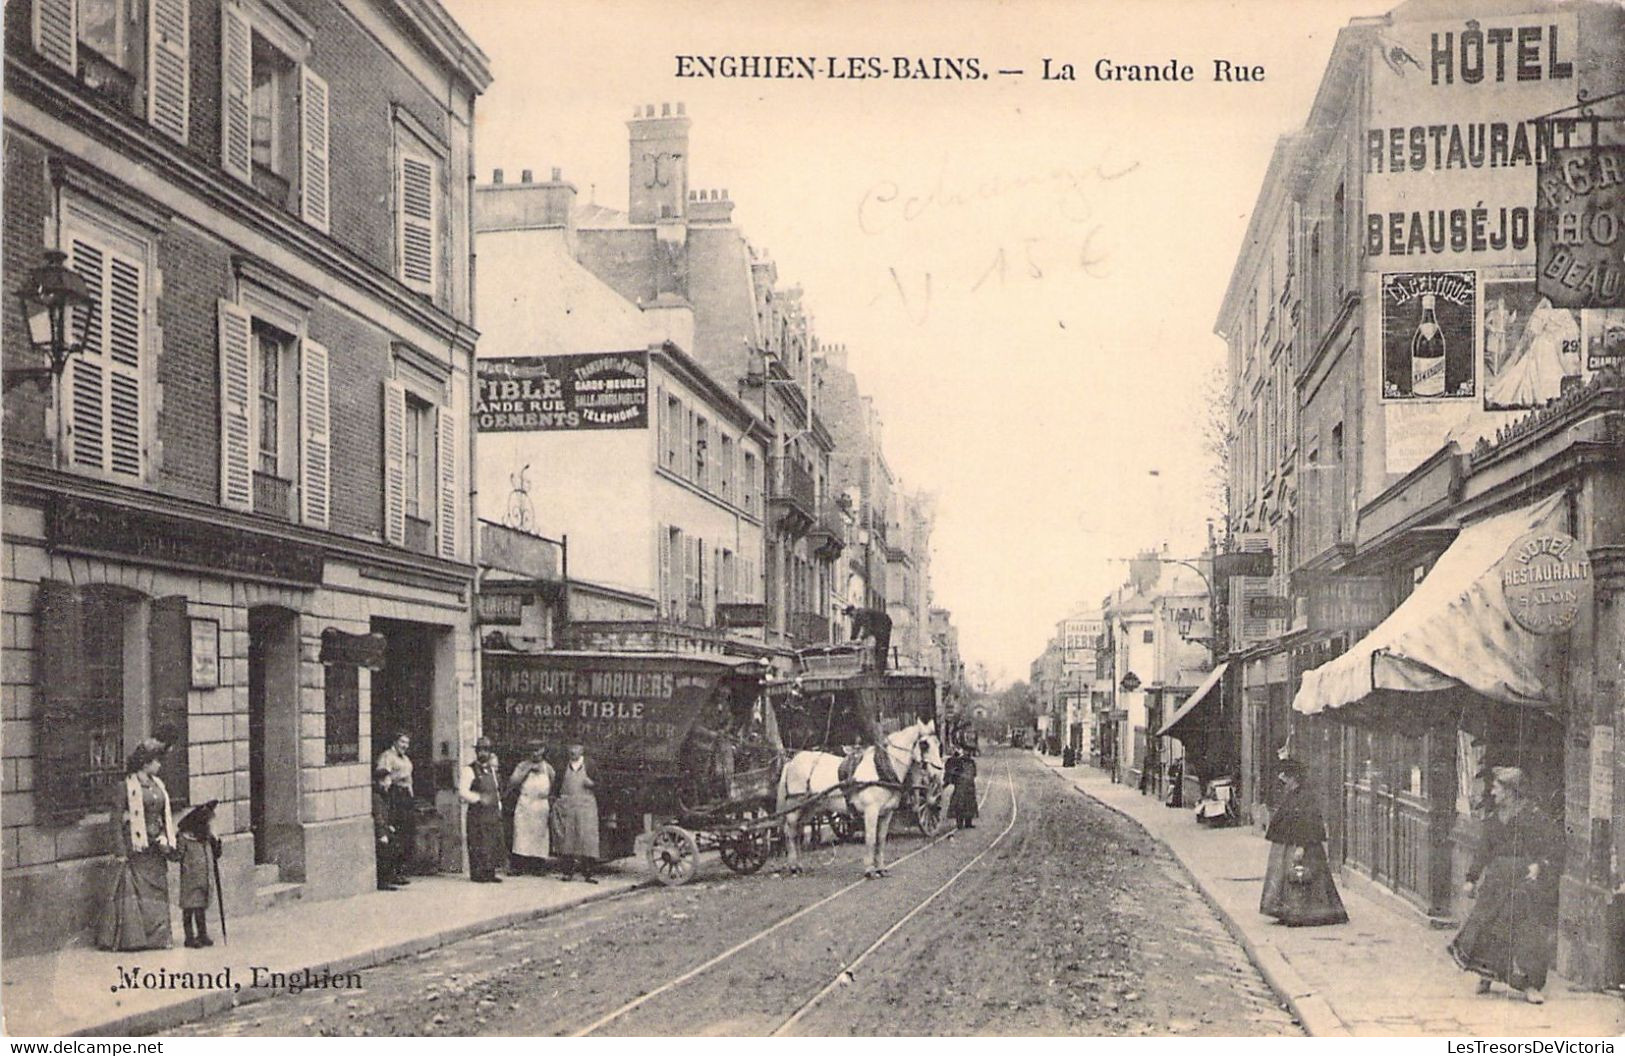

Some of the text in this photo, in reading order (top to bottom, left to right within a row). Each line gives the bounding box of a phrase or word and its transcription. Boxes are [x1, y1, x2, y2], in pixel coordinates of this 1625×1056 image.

[1431, 19, 1573, 85] HÔTEL
[1367, 201, 1538, 257] BEAUSÉJO
[1562, 339, 1579, 354] 29
[530, 400, 566, 412] RUE
[477, 411, 580, 428] GEMENTS
[1504, 561, 1590, 588] RESTAURANT
[1169, 607, 1206, 622] TAAC
[577, 699, 646, 718] TIBLE
